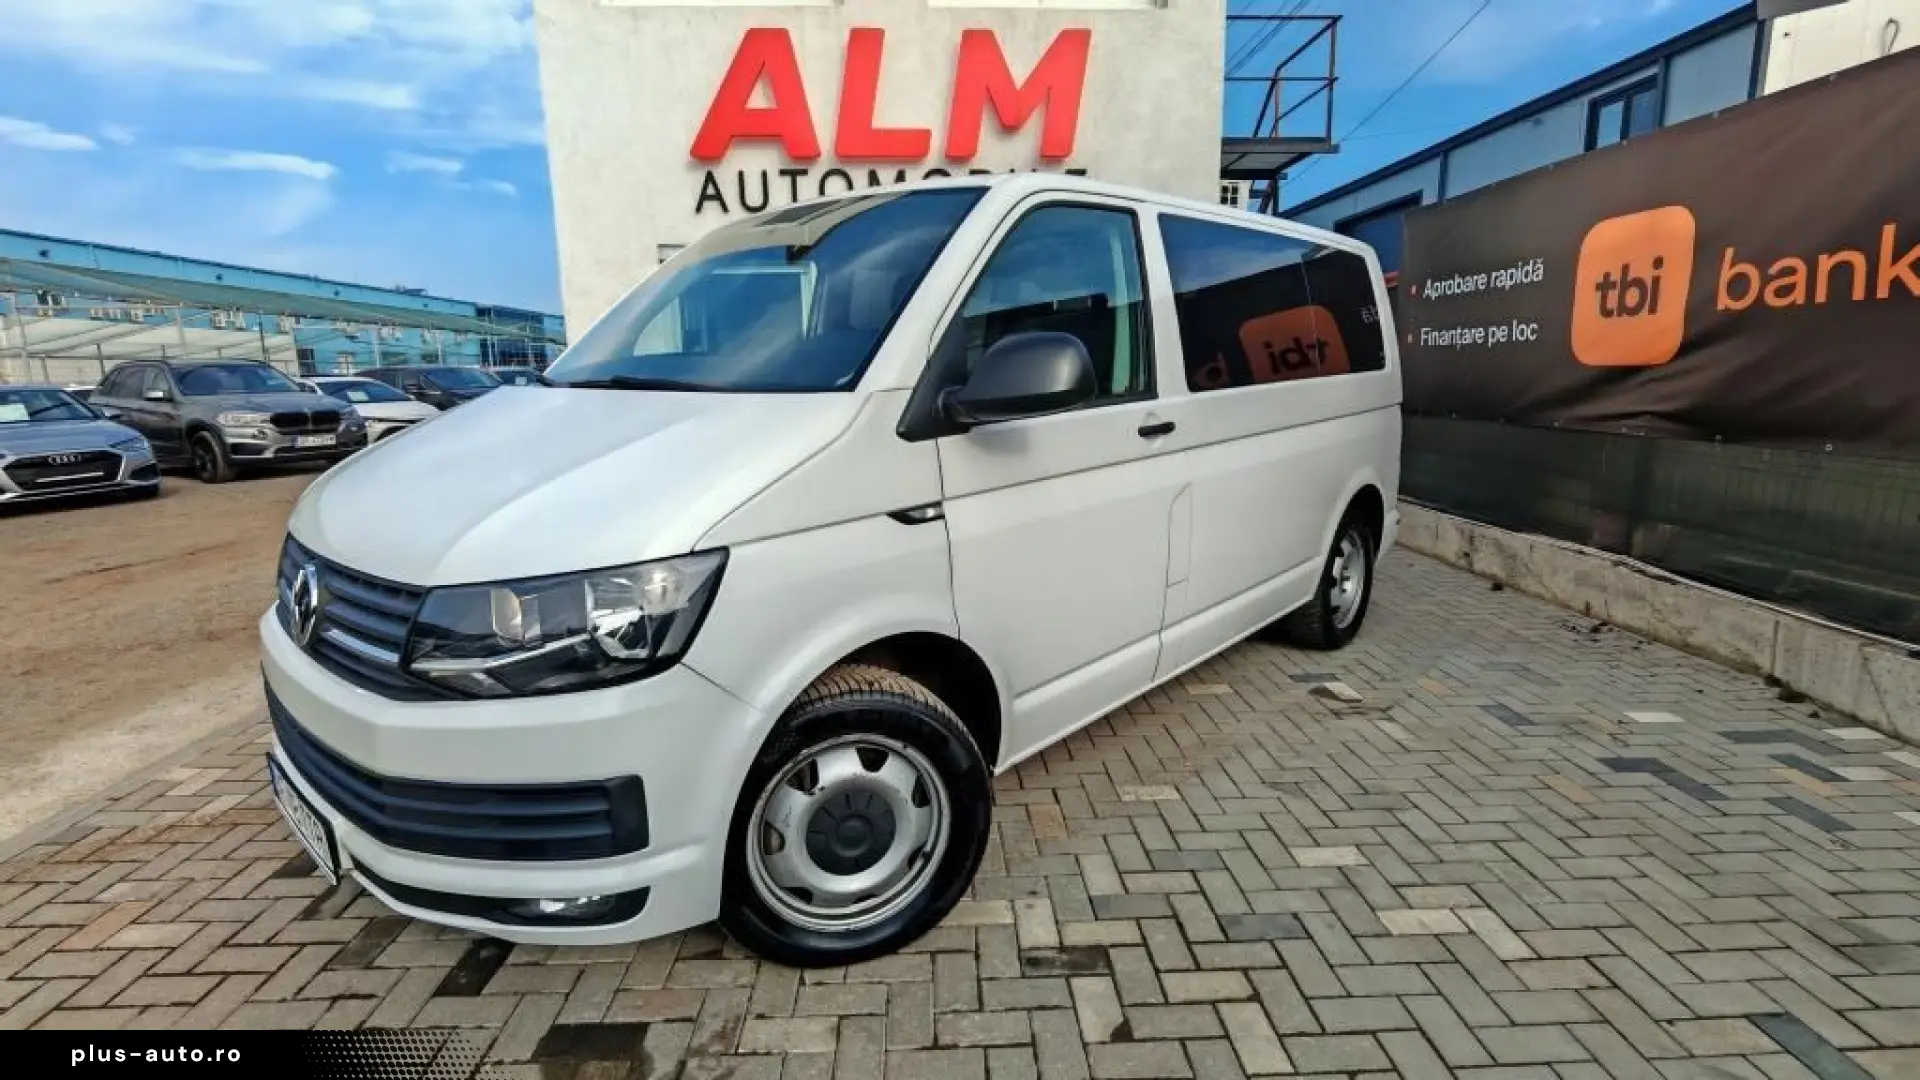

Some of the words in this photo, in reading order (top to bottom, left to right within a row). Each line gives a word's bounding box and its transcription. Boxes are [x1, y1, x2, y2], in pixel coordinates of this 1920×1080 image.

[690, 27, 1092, 161] ALM
[1423, 273, 1487, 300] Aprobare
[1490, 257, 1544, 291] rapidă
[1595, 255, 1664, 317] tbi
[1717, 222, 1920, 311] bank
[1488, 325, 1508, 348] pe
[1512, 319, 1538, 341] loc
